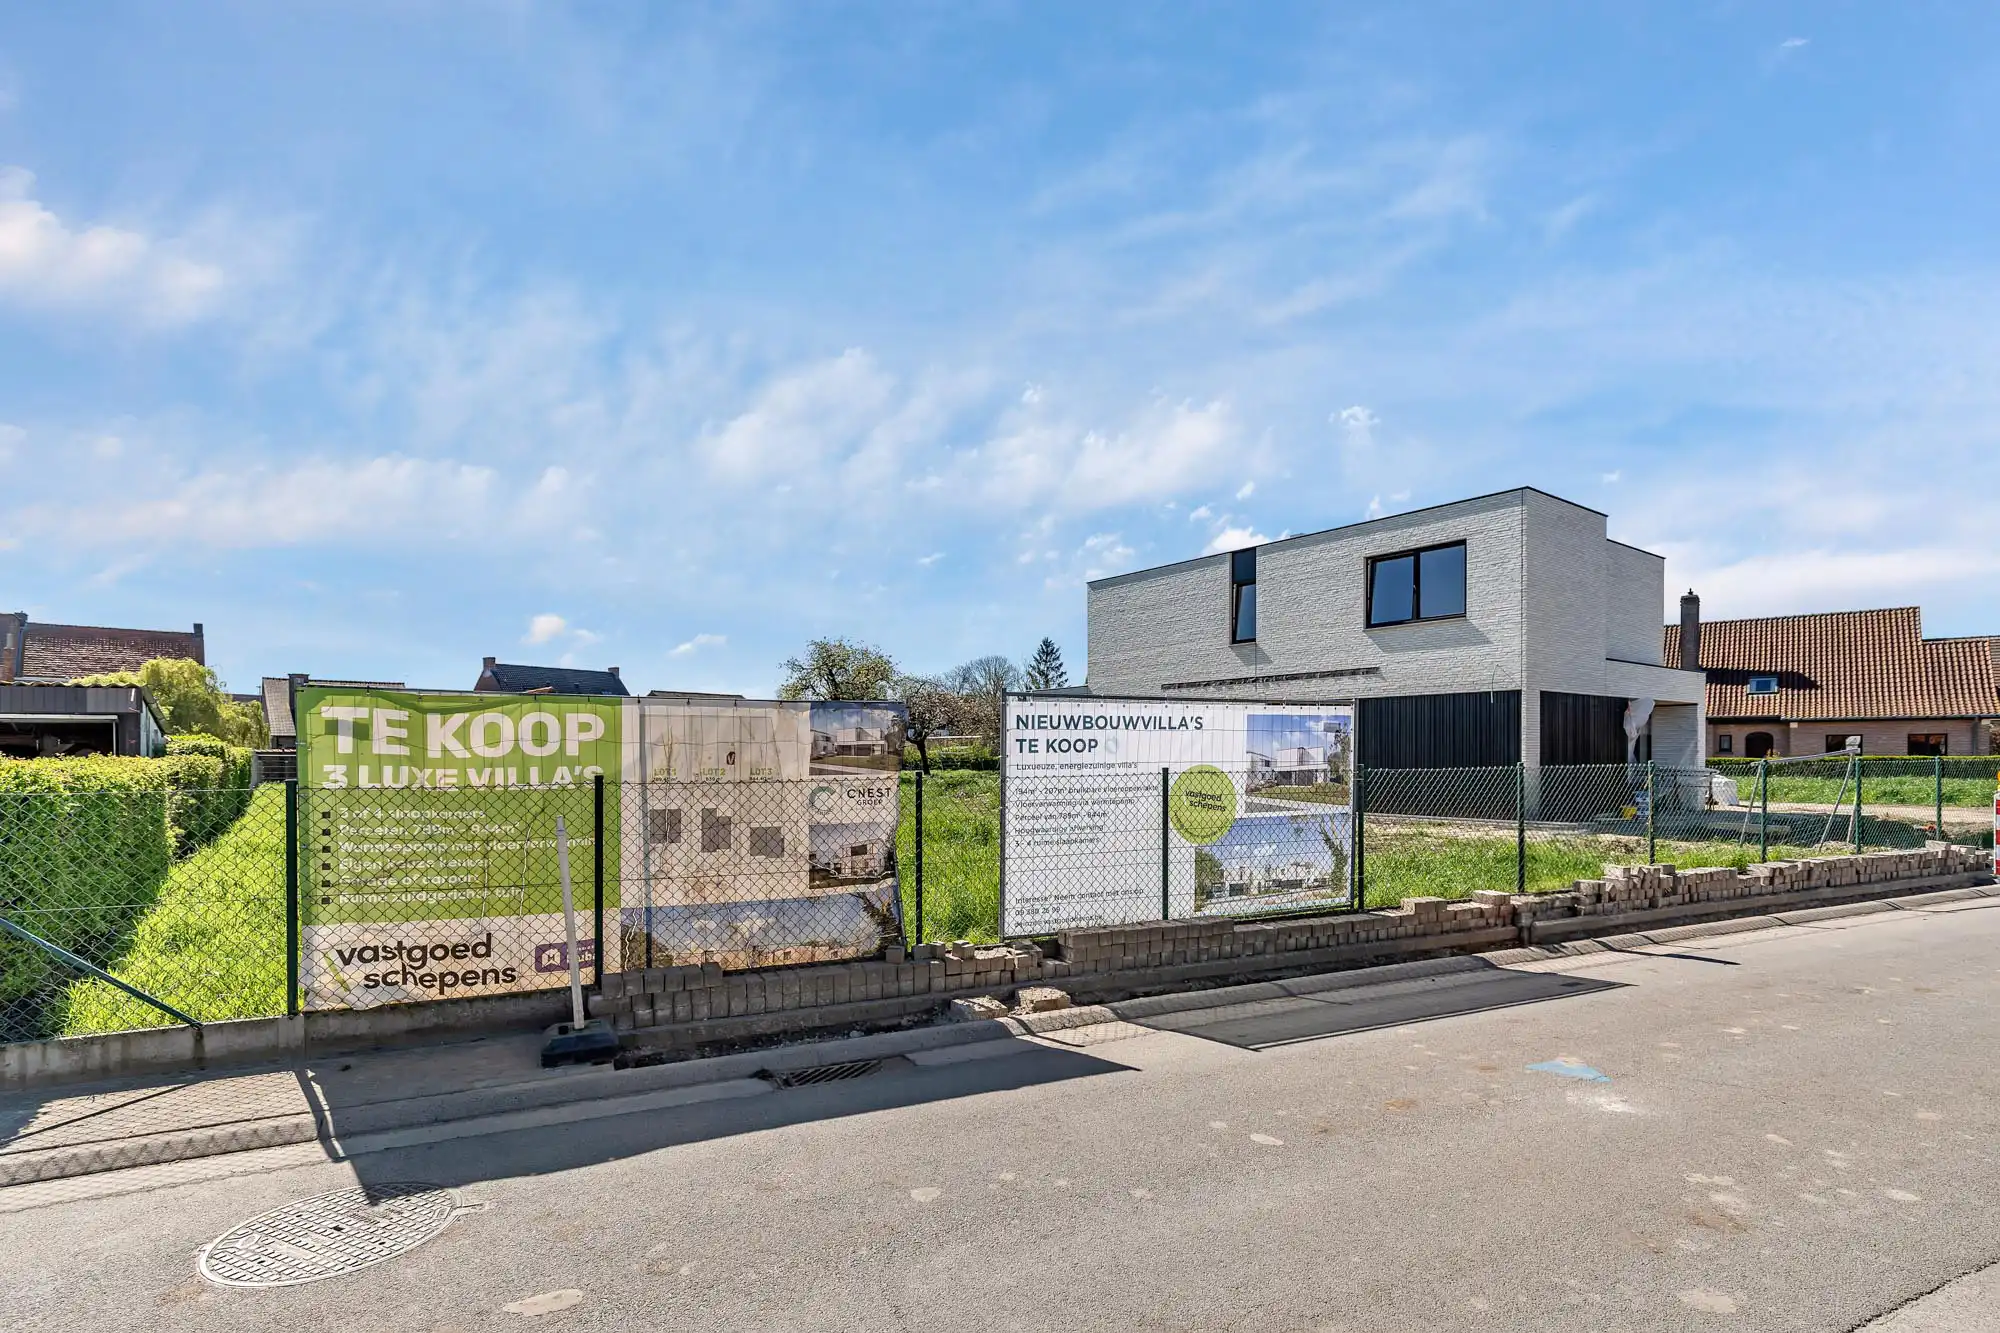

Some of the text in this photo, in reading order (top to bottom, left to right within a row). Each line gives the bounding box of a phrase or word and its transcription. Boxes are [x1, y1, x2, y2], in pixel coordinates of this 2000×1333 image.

[1016, 714, 1204, 730] NIEUWBOUWVILLA'S
[320, 706, 606, 759] TE KOOP
[1016, 738, 1099, 753] TE KOOP
[654, 767, 671, 776] LOT
[702, 767, 726, 776] LOT 2
[749, 767, 773, 776] LOT 3
[1016, 761, 1138, 771] Luxueuze, energiezuinige villa's
[322, 765, 604, 791] 3 LUXE VILLA'S
[847, 787, 891, 799] CNEST
[1185, 789, 1222, 802] vastgoed
[1189, 800, 1227, 812] schepens
[340, 808, 349, 819] 3
[374, 808, 383, 819] 4
[336, 932, 492, 970] vastgoed
[363, 961, 517, 996] schepens
